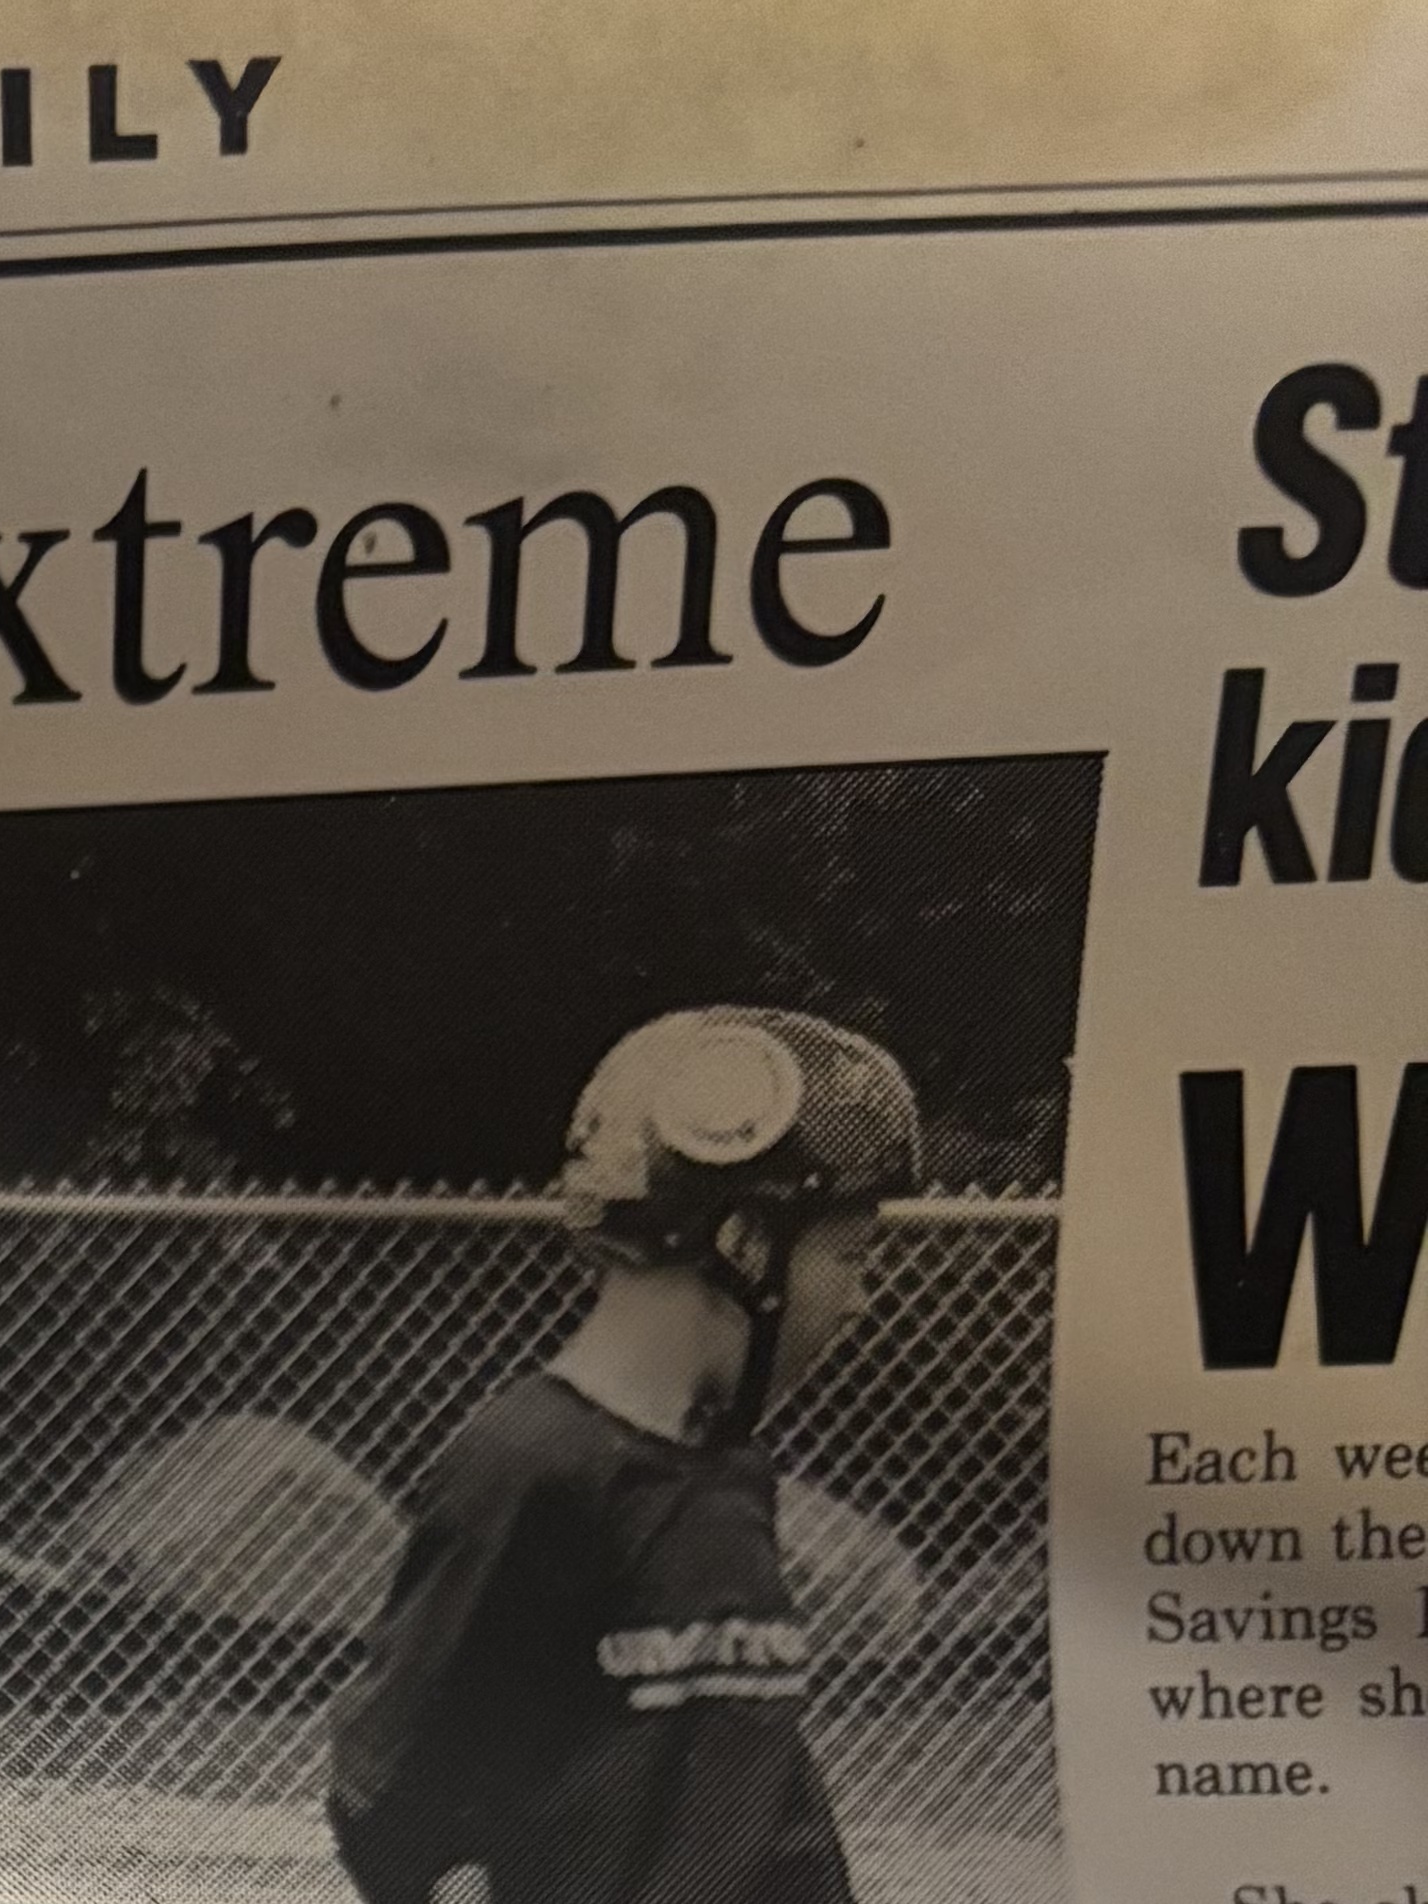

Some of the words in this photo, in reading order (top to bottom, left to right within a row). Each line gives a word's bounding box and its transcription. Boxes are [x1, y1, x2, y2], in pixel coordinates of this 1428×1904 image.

[1145, 1428, 1298, 1486] Each
[1143, 1511, 1304, 1566] down
[1331, 1507, 1428, 1561] the
[1153, 1758, 1331, 1797] name.
